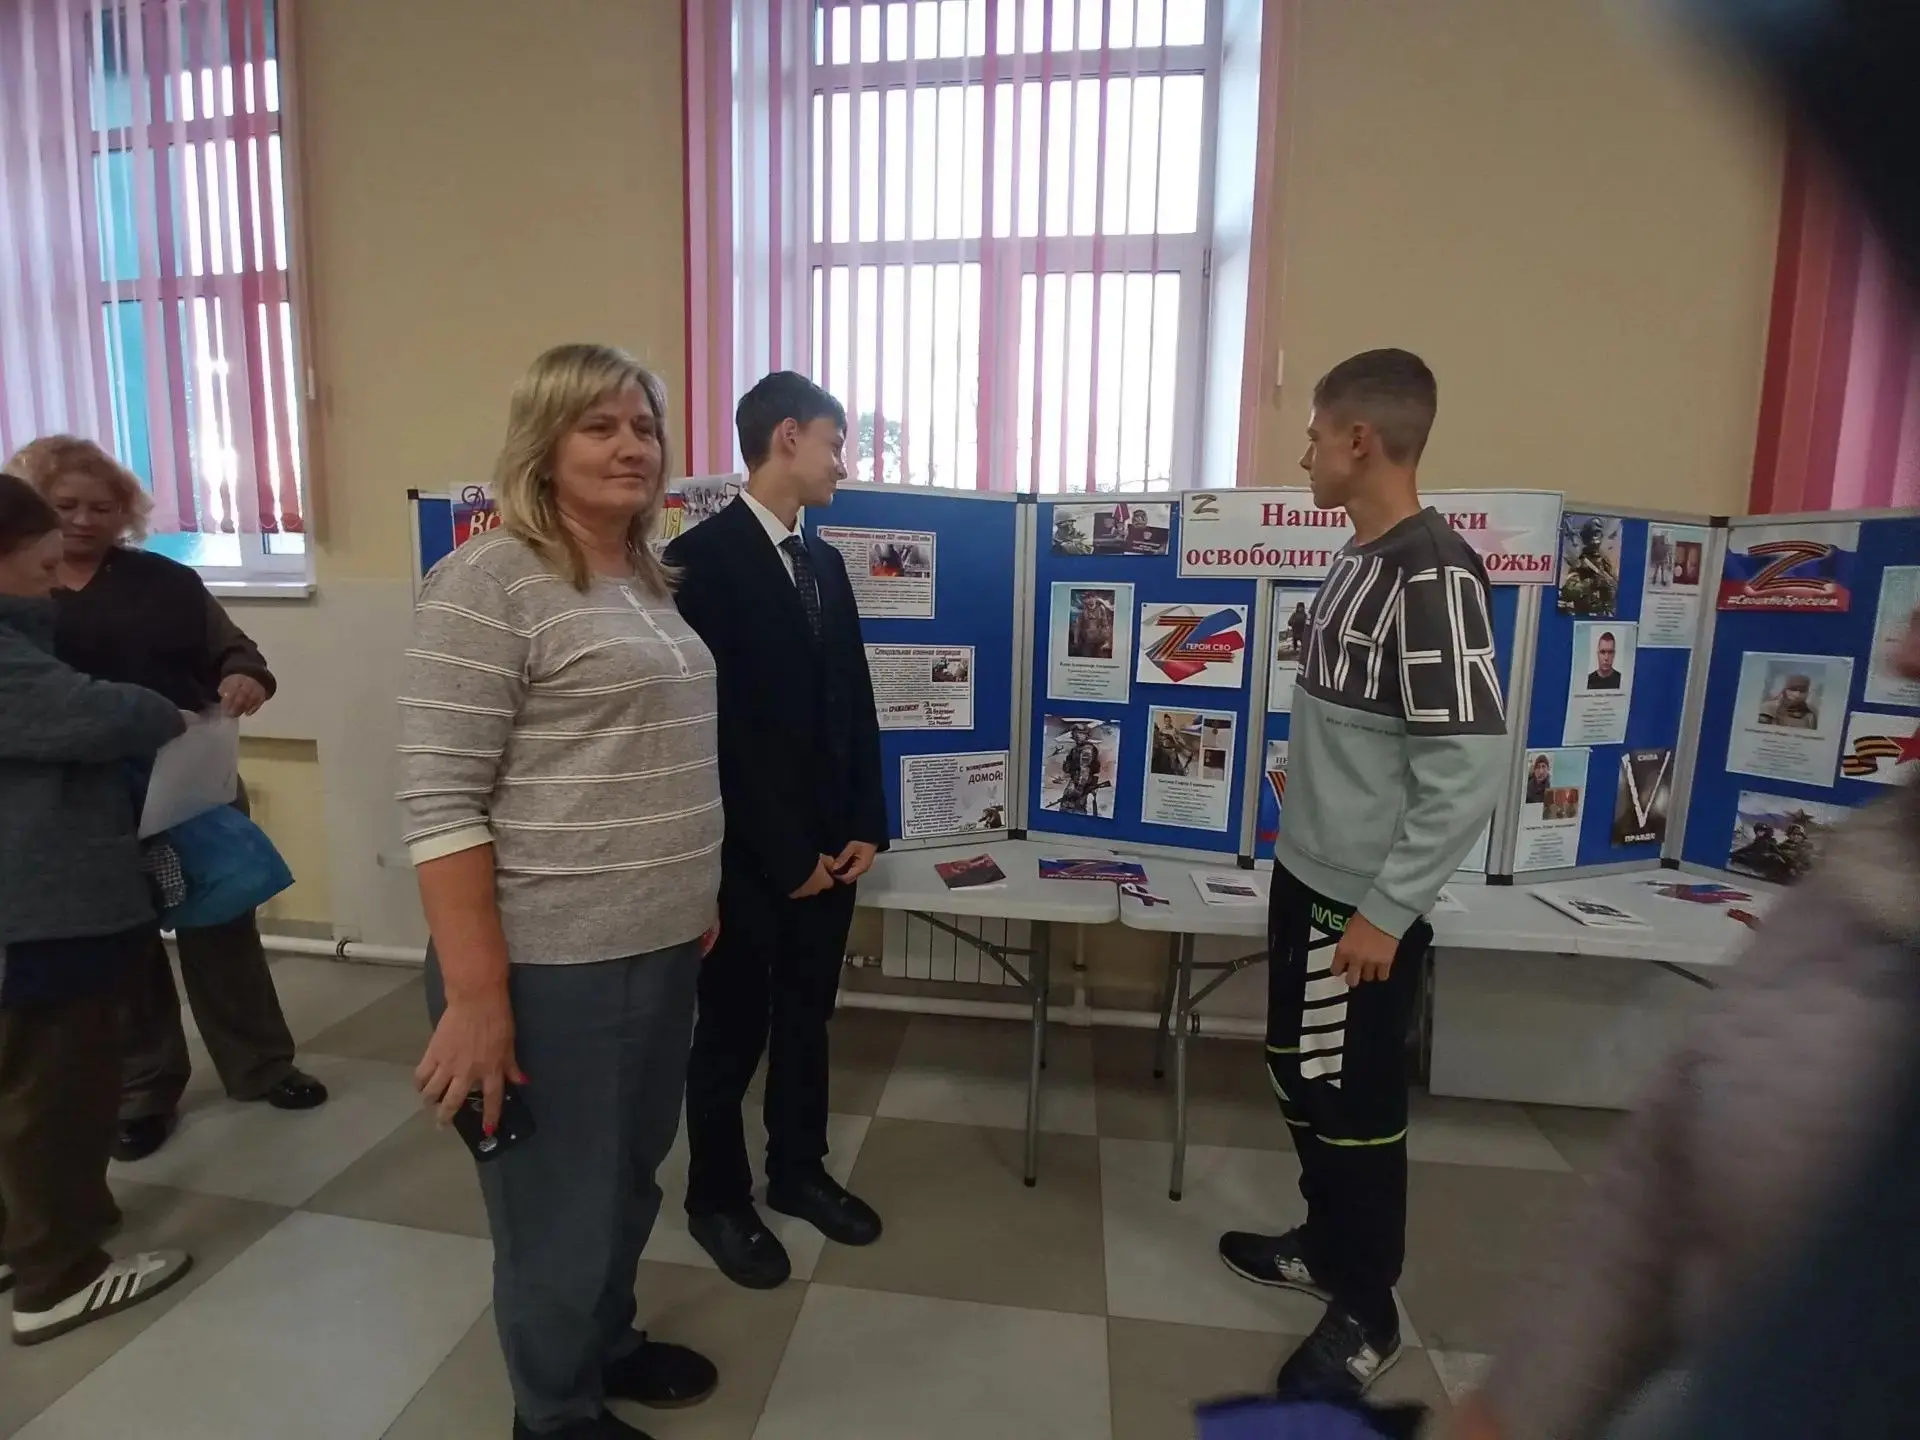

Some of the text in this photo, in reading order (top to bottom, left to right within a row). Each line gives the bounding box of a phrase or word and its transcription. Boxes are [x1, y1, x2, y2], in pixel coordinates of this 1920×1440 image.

[1260, 503, 1488, 530] Наши ки
[1212, 643, 1231, 651] СВО
[968, 770, 1004, 785] ДОМОЙ!
